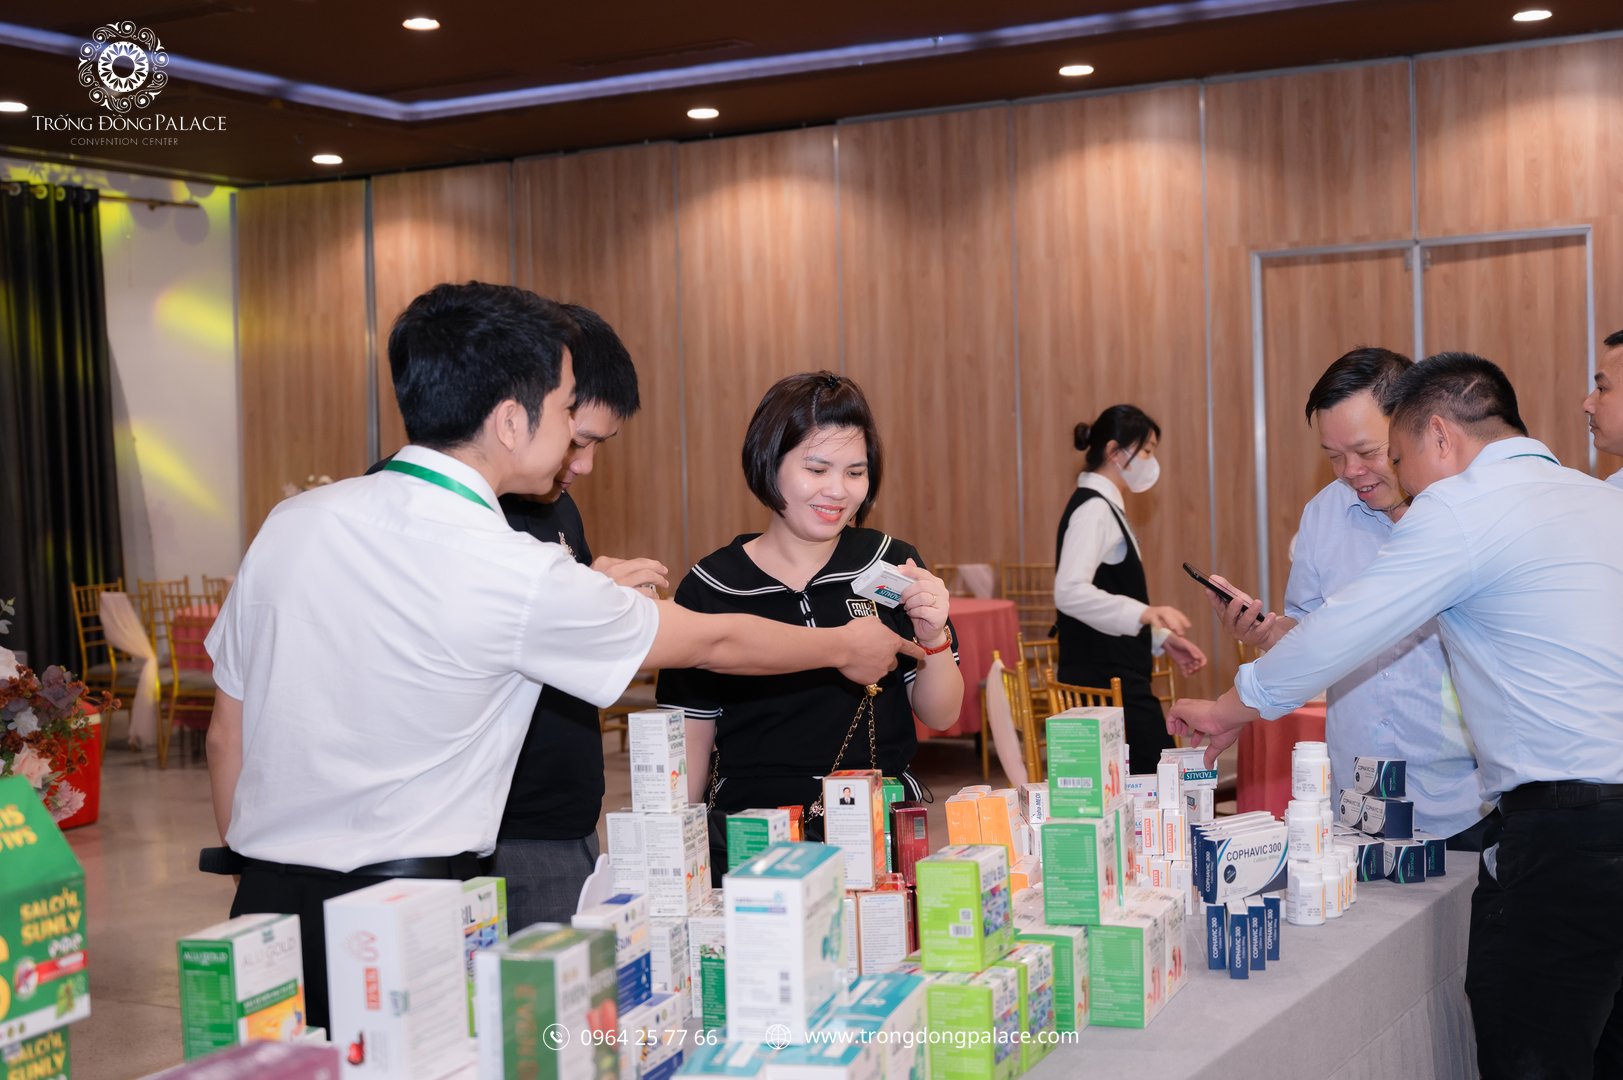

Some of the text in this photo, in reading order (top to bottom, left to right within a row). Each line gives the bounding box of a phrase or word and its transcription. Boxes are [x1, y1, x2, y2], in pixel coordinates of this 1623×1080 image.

[1186, 771, 1213, 780] TADALIS
[1226, 844, 1268, 862] COPHAVIC
[1269, 842, 1282, 854] 300
